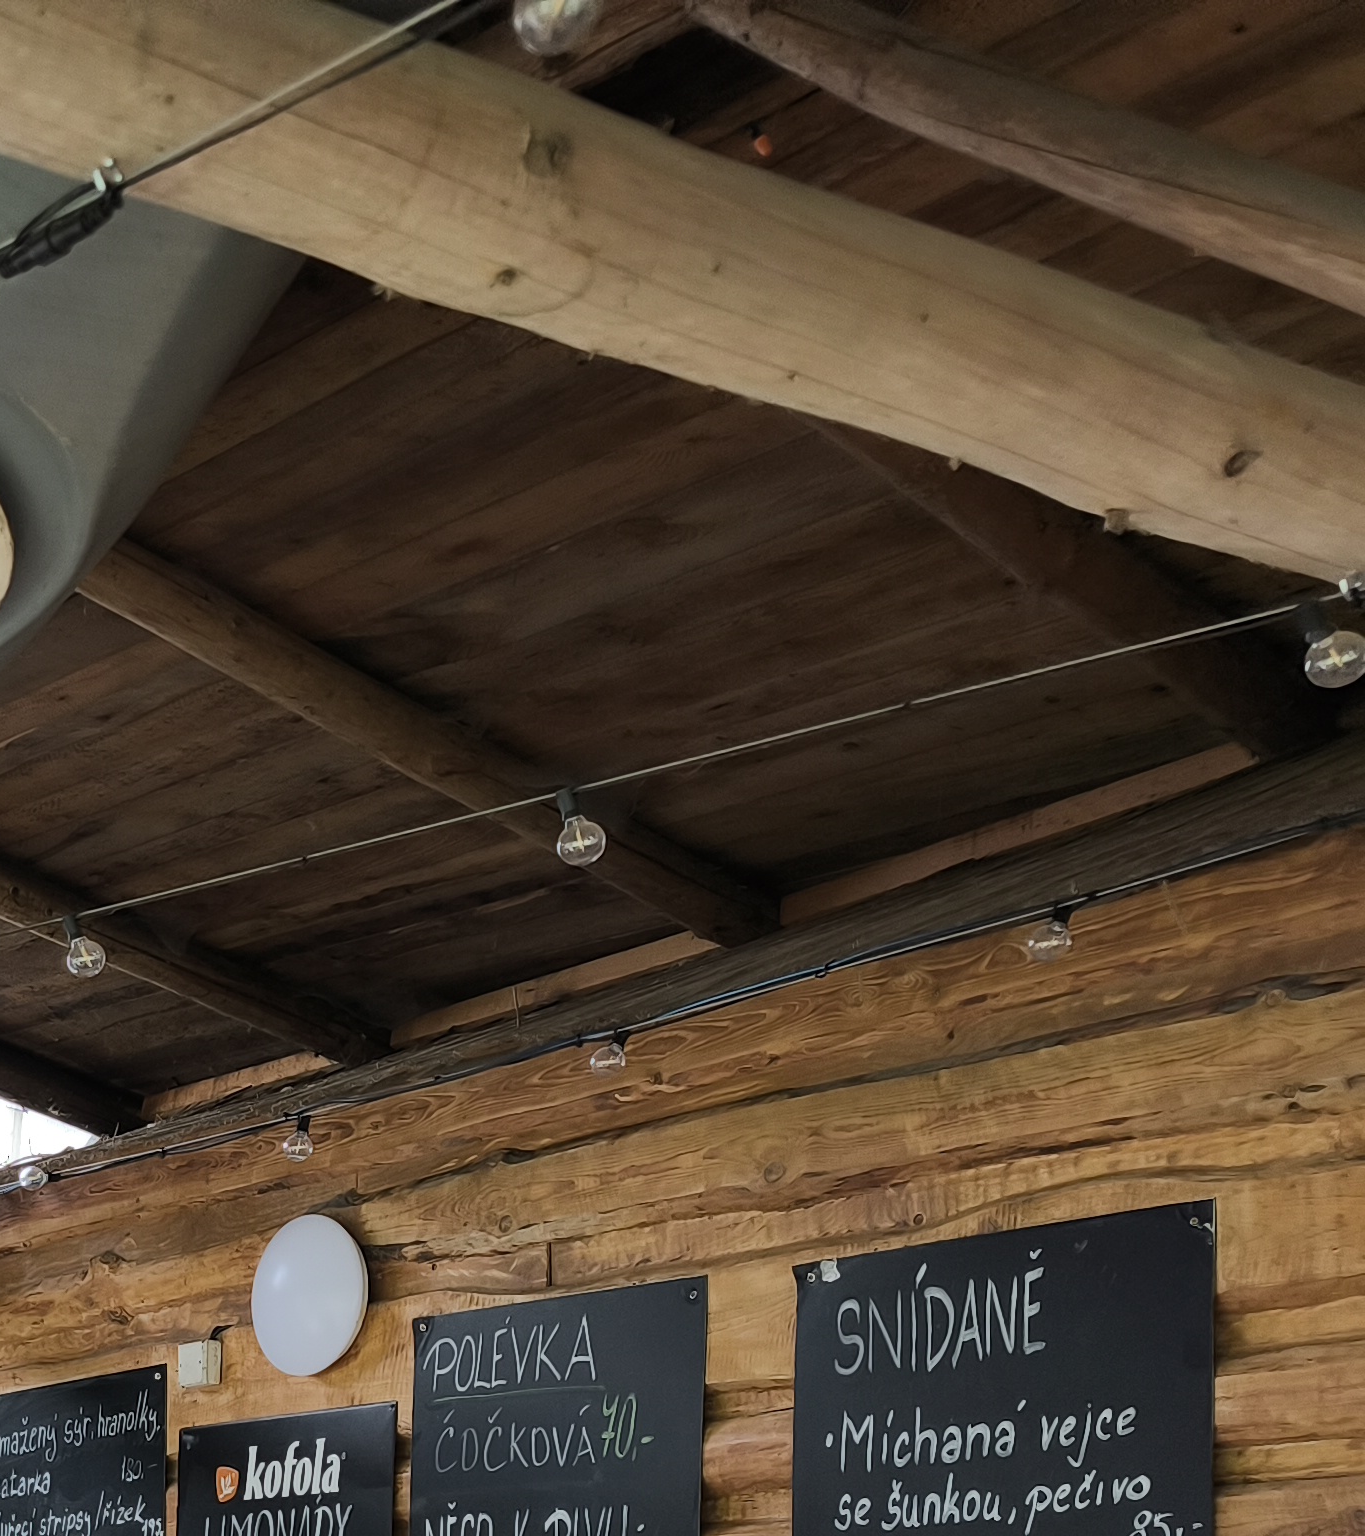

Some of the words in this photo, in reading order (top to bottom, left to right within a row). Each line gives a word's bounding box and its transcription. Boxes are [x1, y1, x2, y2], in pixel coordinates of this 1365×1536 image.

[834, 1249, 1046, 1375] SNÍDANĚ
[423, 1313, 596, 1392] POLÉVKA
[1041, 1404, 1137, 1467] vejce
[244, 1438, 341, 1500] kofola
[835, 1494, 871, 1531] se
[1025, 1470, 1151, 1535] pečivo
